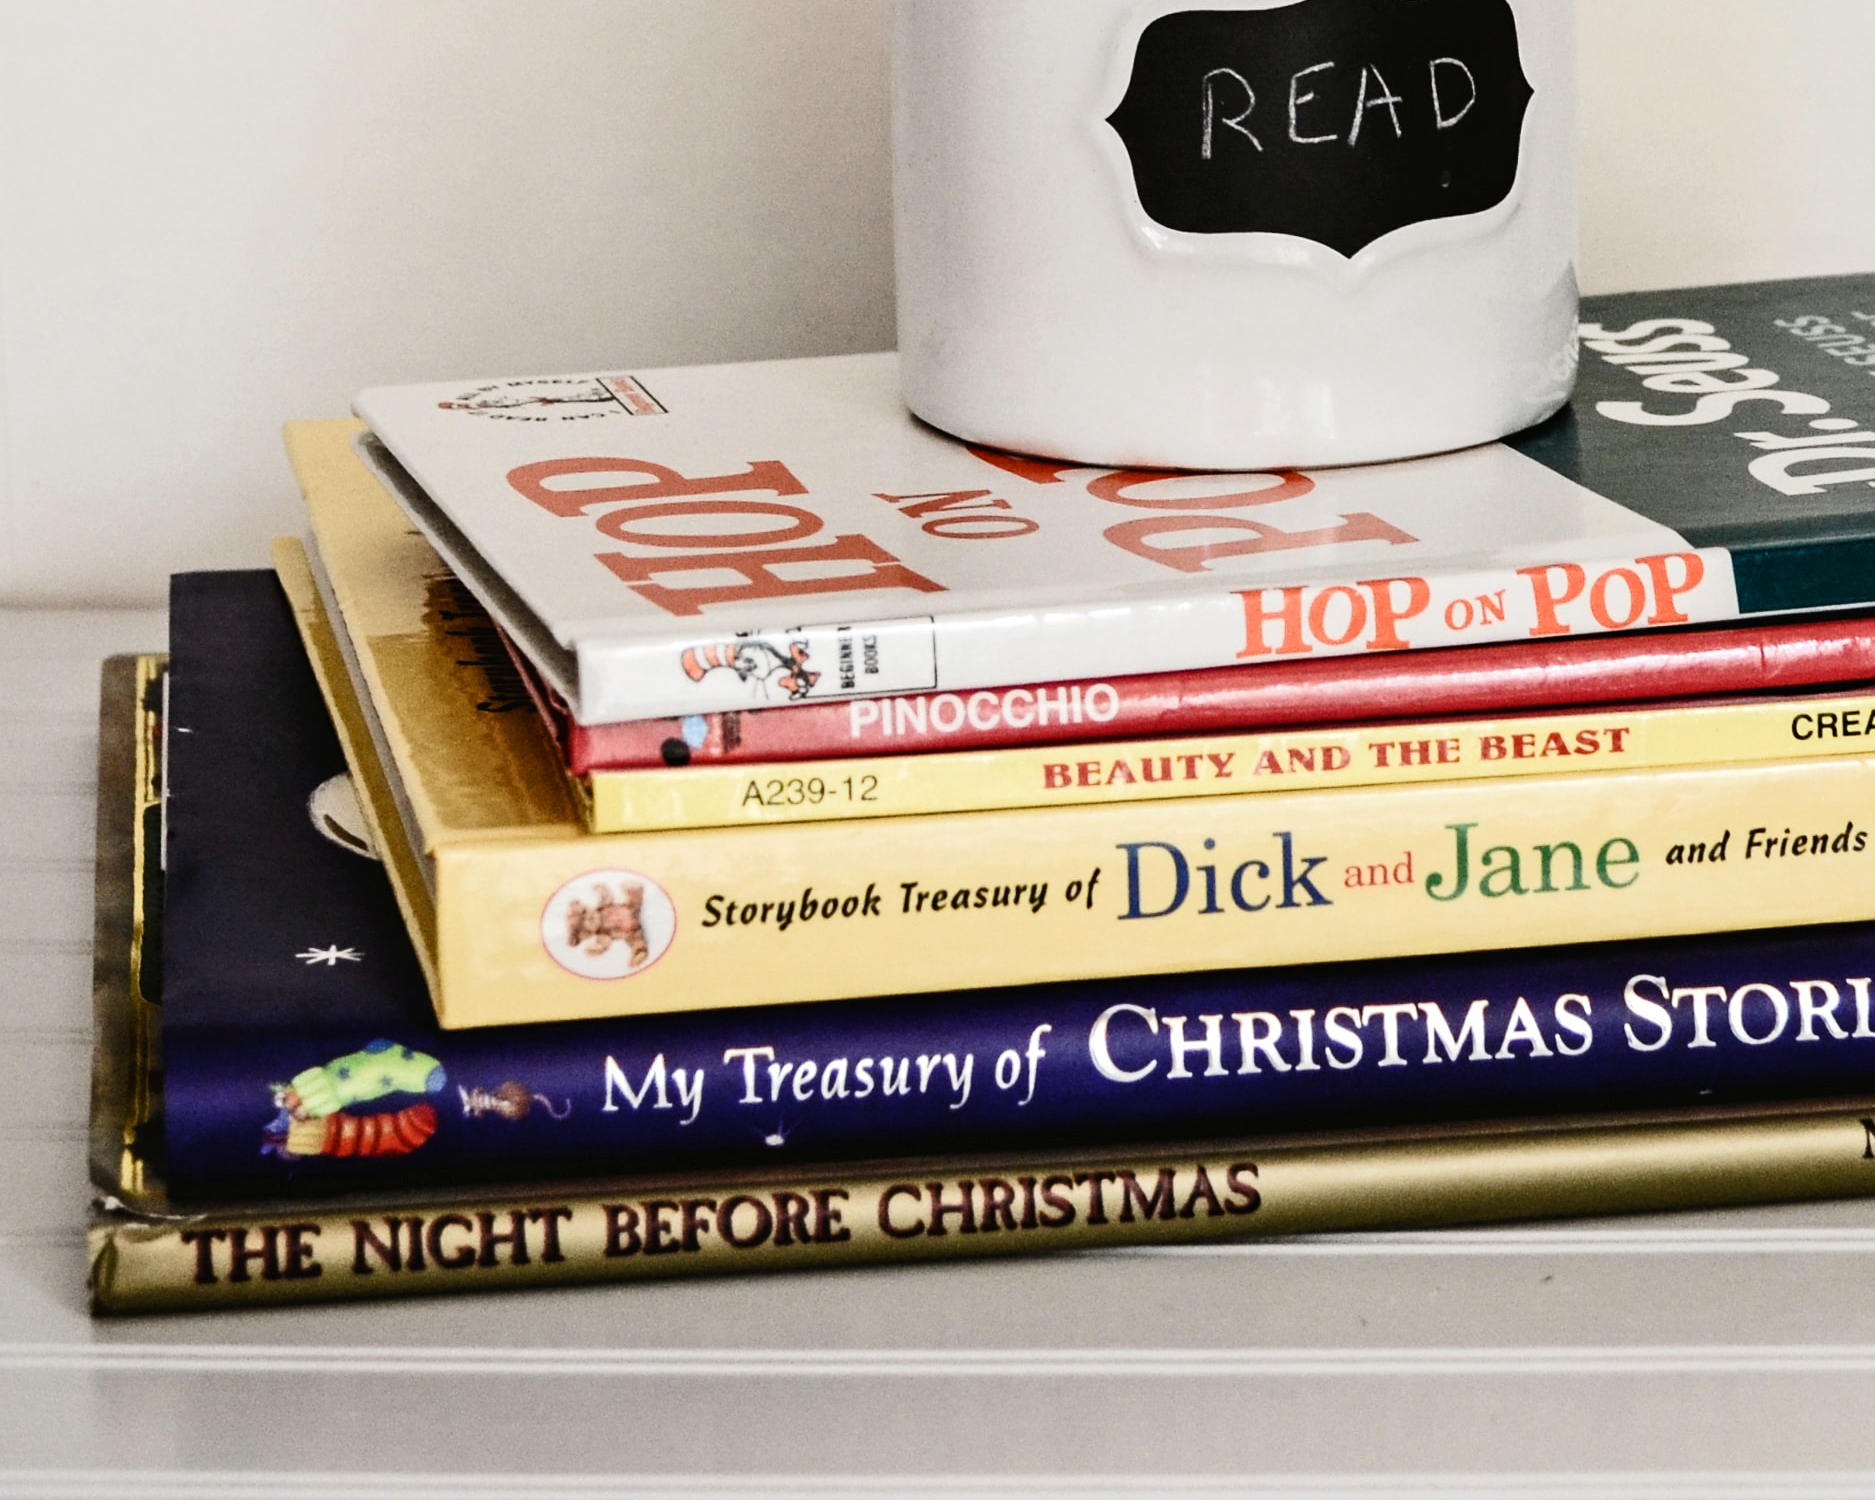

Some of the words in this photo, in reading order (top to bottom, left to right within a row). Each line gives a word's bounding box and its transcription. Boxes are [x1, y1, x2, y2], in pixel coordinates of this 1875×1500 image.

[1201, 57, 1476, 159] READ
[1579, 318, 1831, 426] Seuss
[506, 455, 949, 617] HOP
[872, 488, 1040, 541] ON
[863, 635, 879, 674] BOOKS
[1230, 576, 1430, 659] HOP
[1444, 589, 1506, 630] ON
[1515, 552, 1704, 636] POP
[849, 683, 1120, 738] PINOCCHIO
[1043, 752, 1234, 789] BEAUTY
[1253, 745, 1351, 776] AND
[1368, 737, 1460, 768] THE
[1479, 727, 1630, 761] BEAST
[741, 775, 878, 807] A239-12
[702, 884, 882, 933] Storybook
[900, 877, 1049, 915] Treasury
[1065, 867, 1101, 909] of
[1116, 832, 1333, 921] Dick
[1344, 851, 1415, 888] and
[1425, 821, 1640, 902] Jane
[1665, 830, 1730, 866] and
[1745, 821, 1869, 860] Friends
[602, 1054, 705, 1125] My
[724, 1046, 973, 1110] Treasury
[995, 1024, 1052, 1106] of
[1088, 994, 1594, 1083] CHRISTMAS
[182, 1222, 322, 1284] THE
[350, 1206, 572, 1275] NIGHT
[602, 1188, 850, 1259] BEFORE
[877, 1162, 1262, 1239] CHRISTMAS
